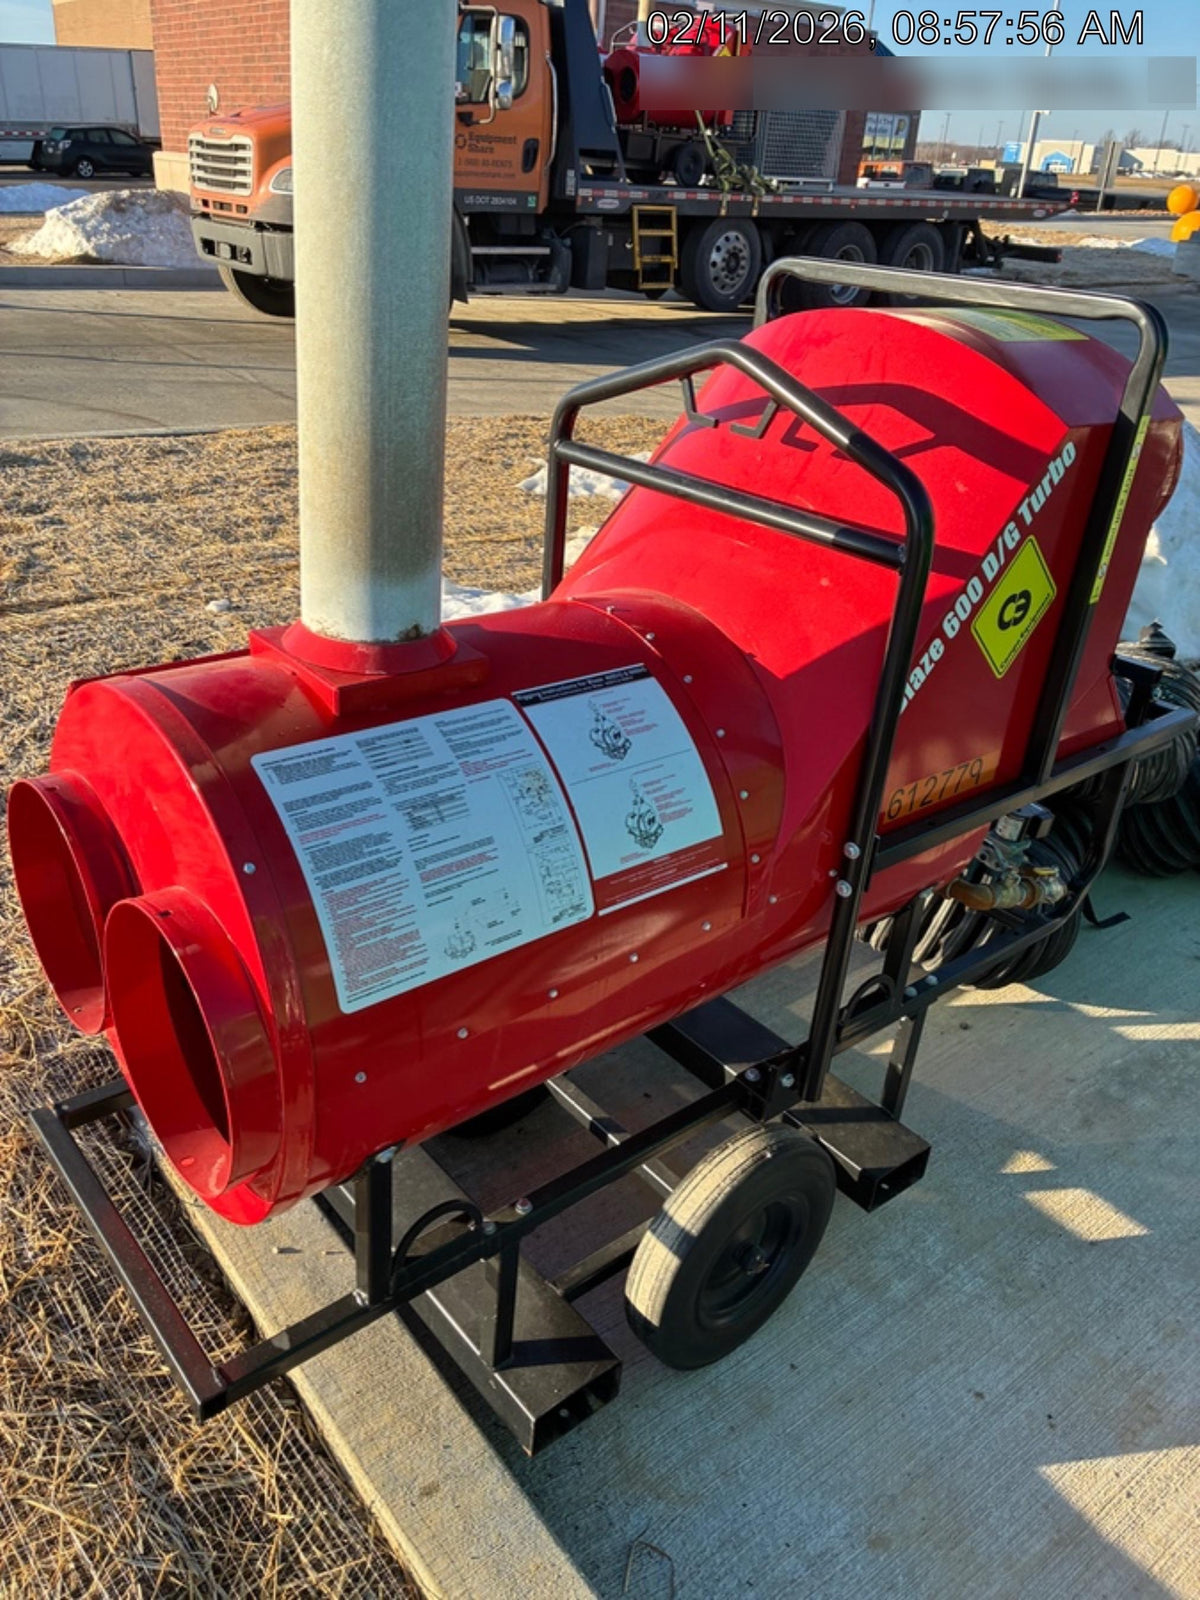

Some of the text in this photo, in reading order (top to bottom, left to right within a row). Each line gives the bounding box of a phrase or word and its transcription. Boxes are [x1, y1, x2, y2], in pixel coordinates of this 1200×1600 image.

[468, 132, 517, 145] Equipment
[468, 144, 495, 154] Share
[900, 441, 1076, 715] laze 600 D/G Turbo
[886, 757, 984, 819] 612779
